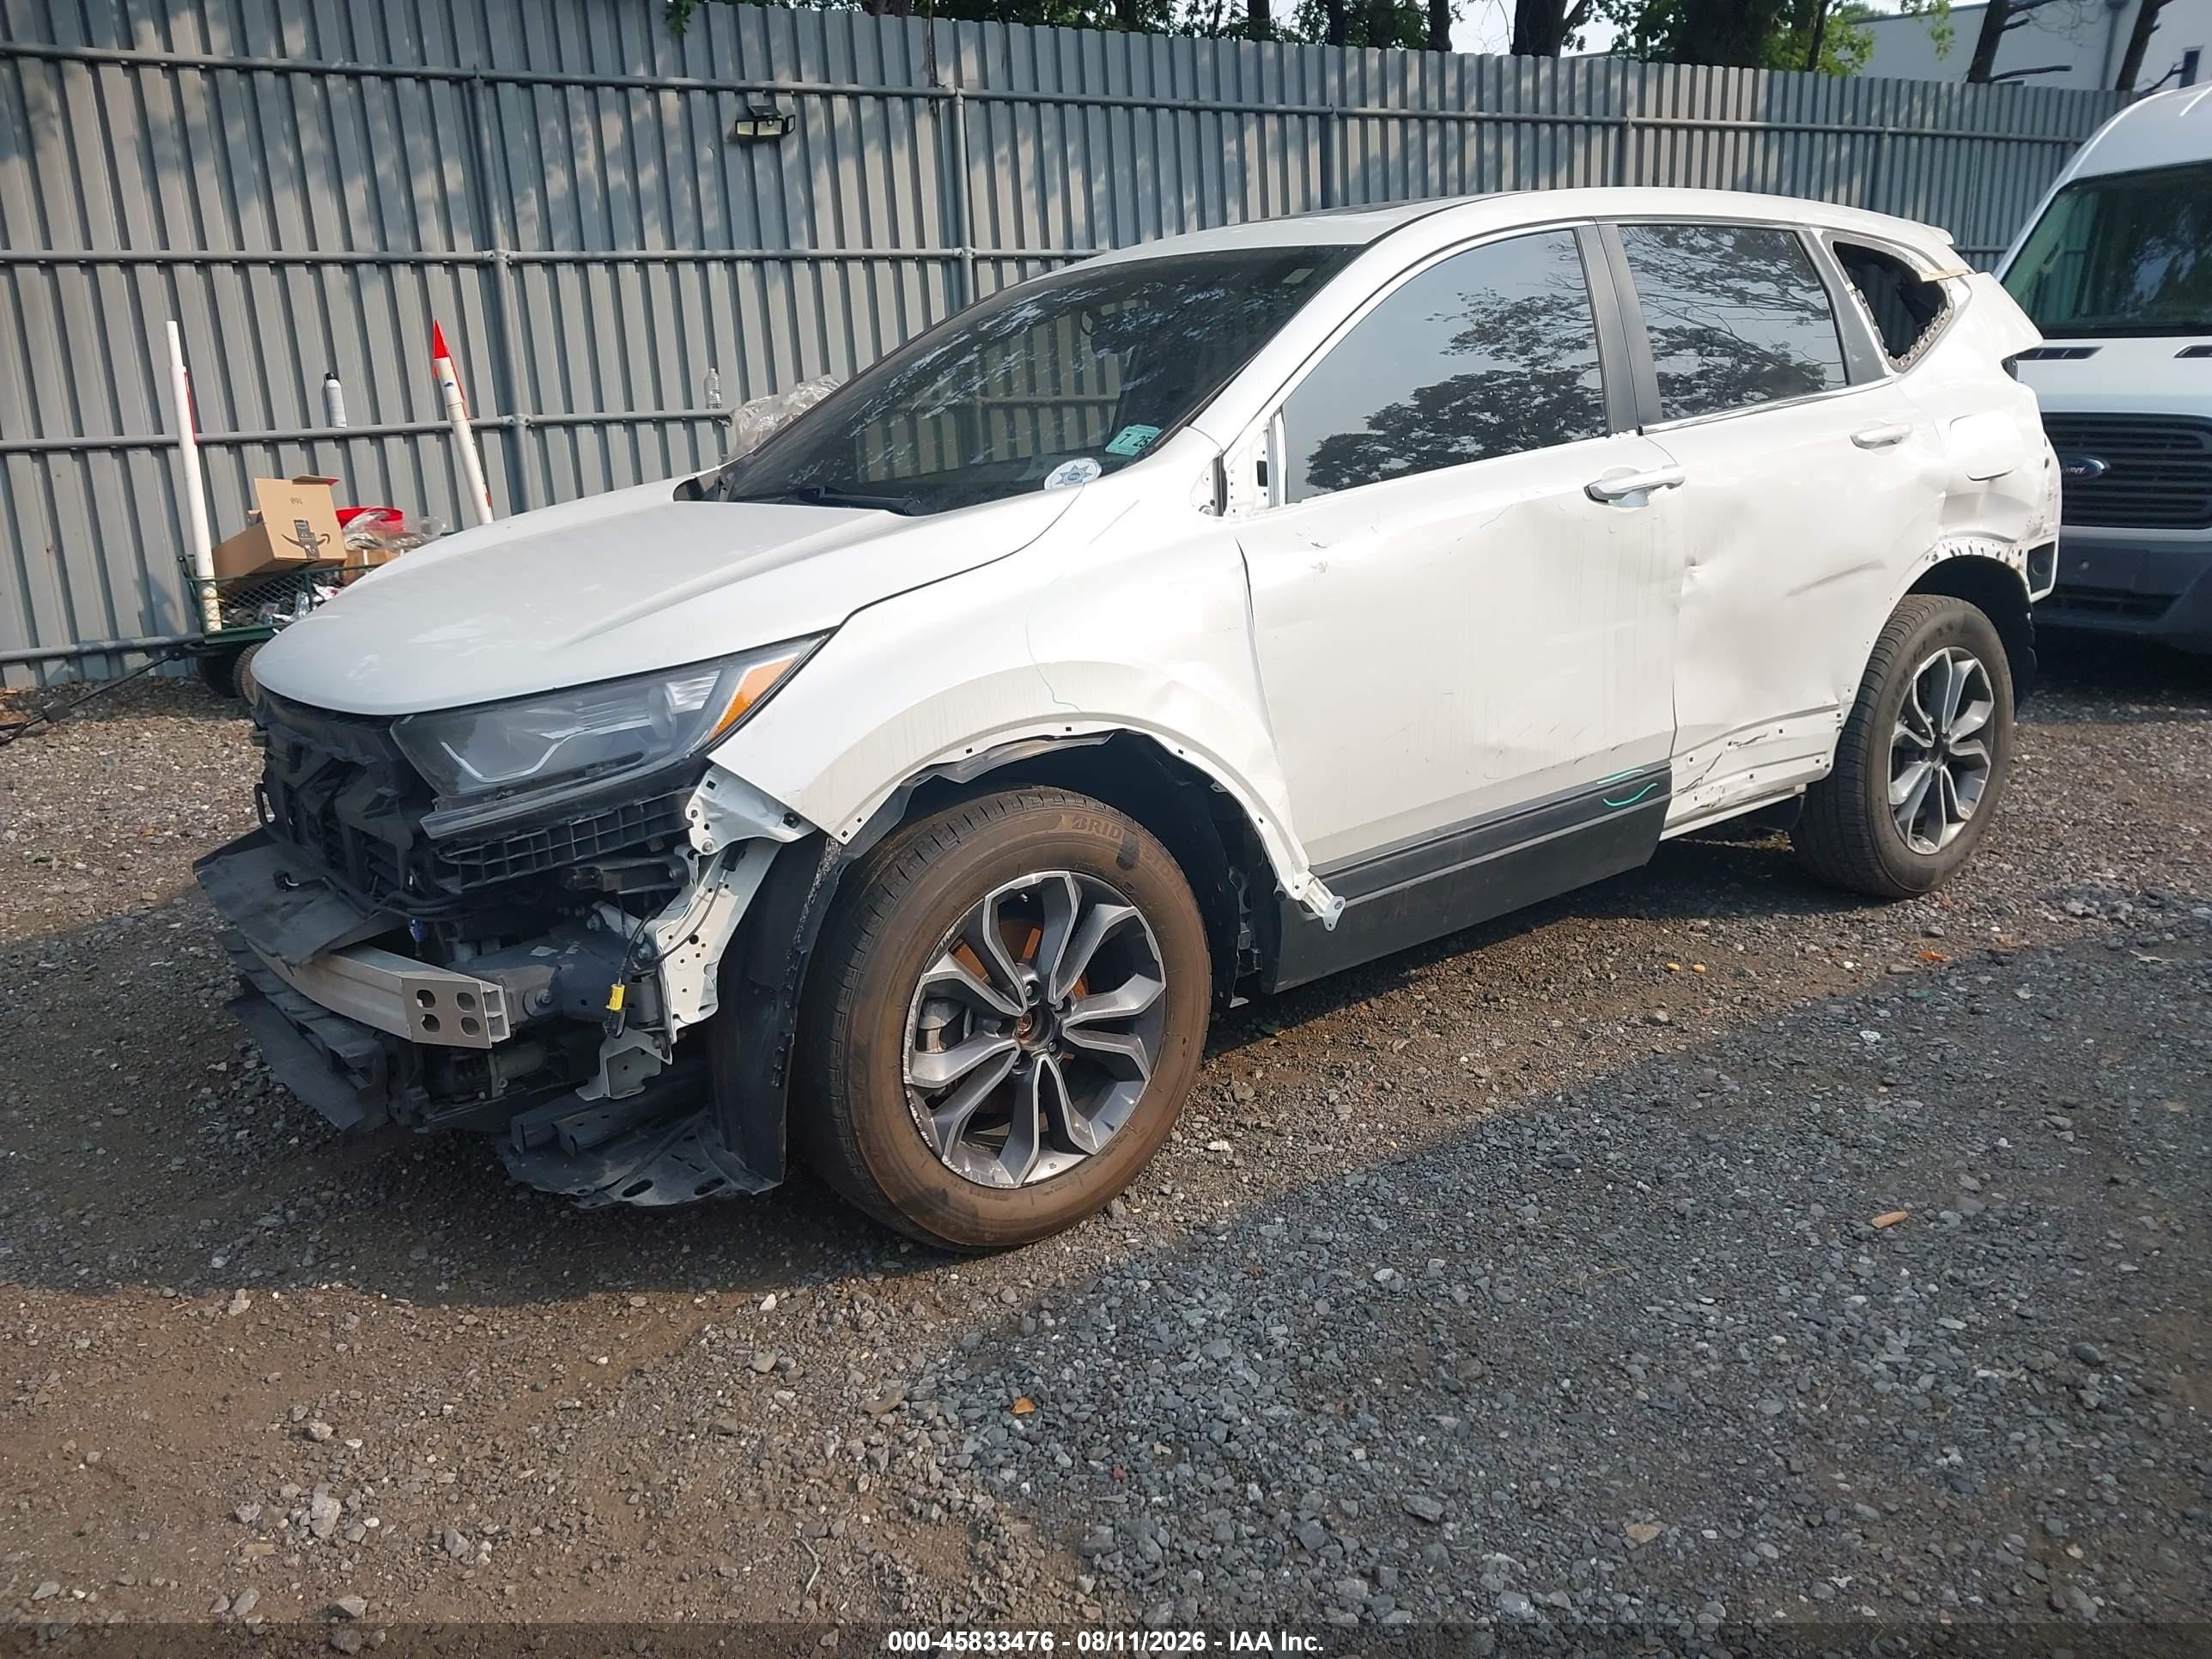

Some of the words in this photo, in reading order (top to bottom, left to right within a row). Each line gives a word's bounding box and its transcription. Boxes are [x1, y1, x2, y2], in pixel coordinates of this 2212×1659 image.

[1118, 433, 1132, 445] 7
[1133, 435, 1152, 447] 25
[1072, 815, 1183, 902] BRIDSTONE
